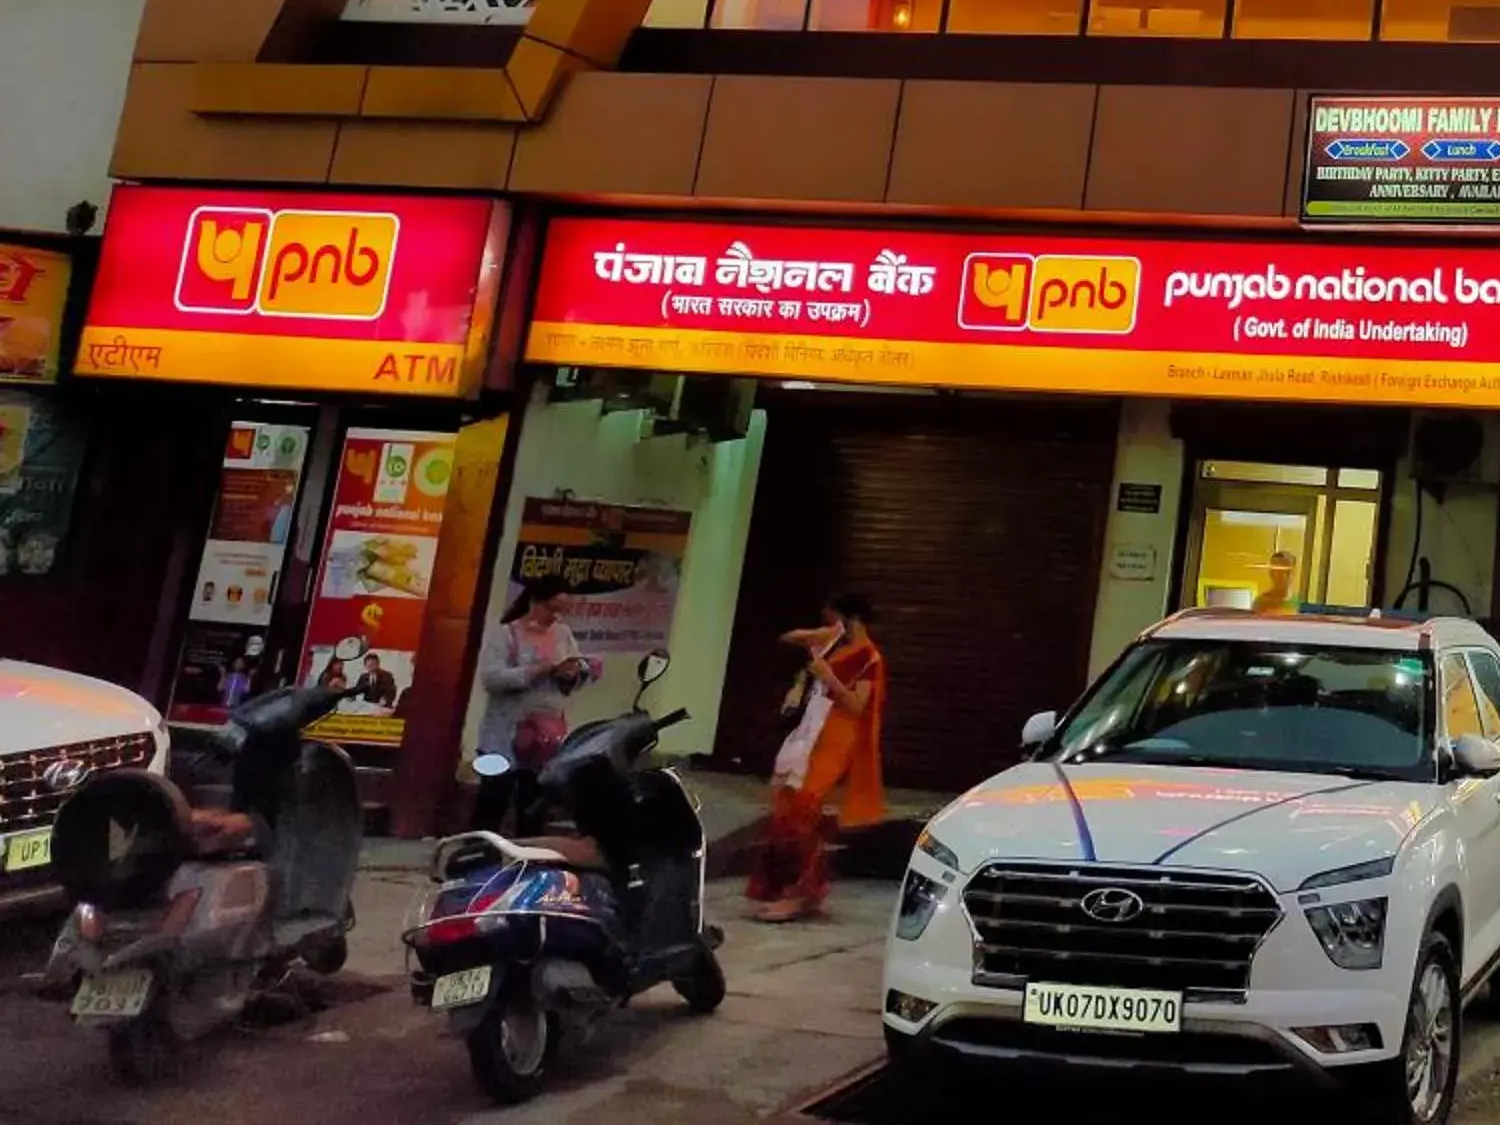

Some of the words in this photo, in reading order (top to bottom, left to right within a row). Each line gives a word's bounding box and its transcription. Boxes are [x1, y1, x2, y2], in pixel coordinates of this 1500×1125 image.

[1314, 106, 1423, 132] DEVBHOOMI
[1427, 107, 1493, 133] FAMILY
[1447, 143, 1477, 156] Lunch
[1317, 167, 1374, 181] BIRTHDAY
[1415, 167, 1449, 182] KITTY
[268, 226, 379, 300] pnb
[866, 249, 936, 296] बैंक
[1037, 266, 1127, 320] pnb
[1163, 263, 1290, 308] punjab
[1295, 266, 1447, 306] national
[660, 290, 711, 320] (भारत
[718, 294, 774, 318] सरकार
[778, 299, 801, 320] का
[806, 298, 872, 328] उपक्रम)
[1292, 318, 1313, 339] of
[1313, 318, 1355, 341] India
[1358, 321, 1469, 348] Undertaking)
[88, 336, 162, 370] एटीएम
[373, 352, 457, 383] ATM
[1039, 990, 1176, 1023] UK07DX9070
